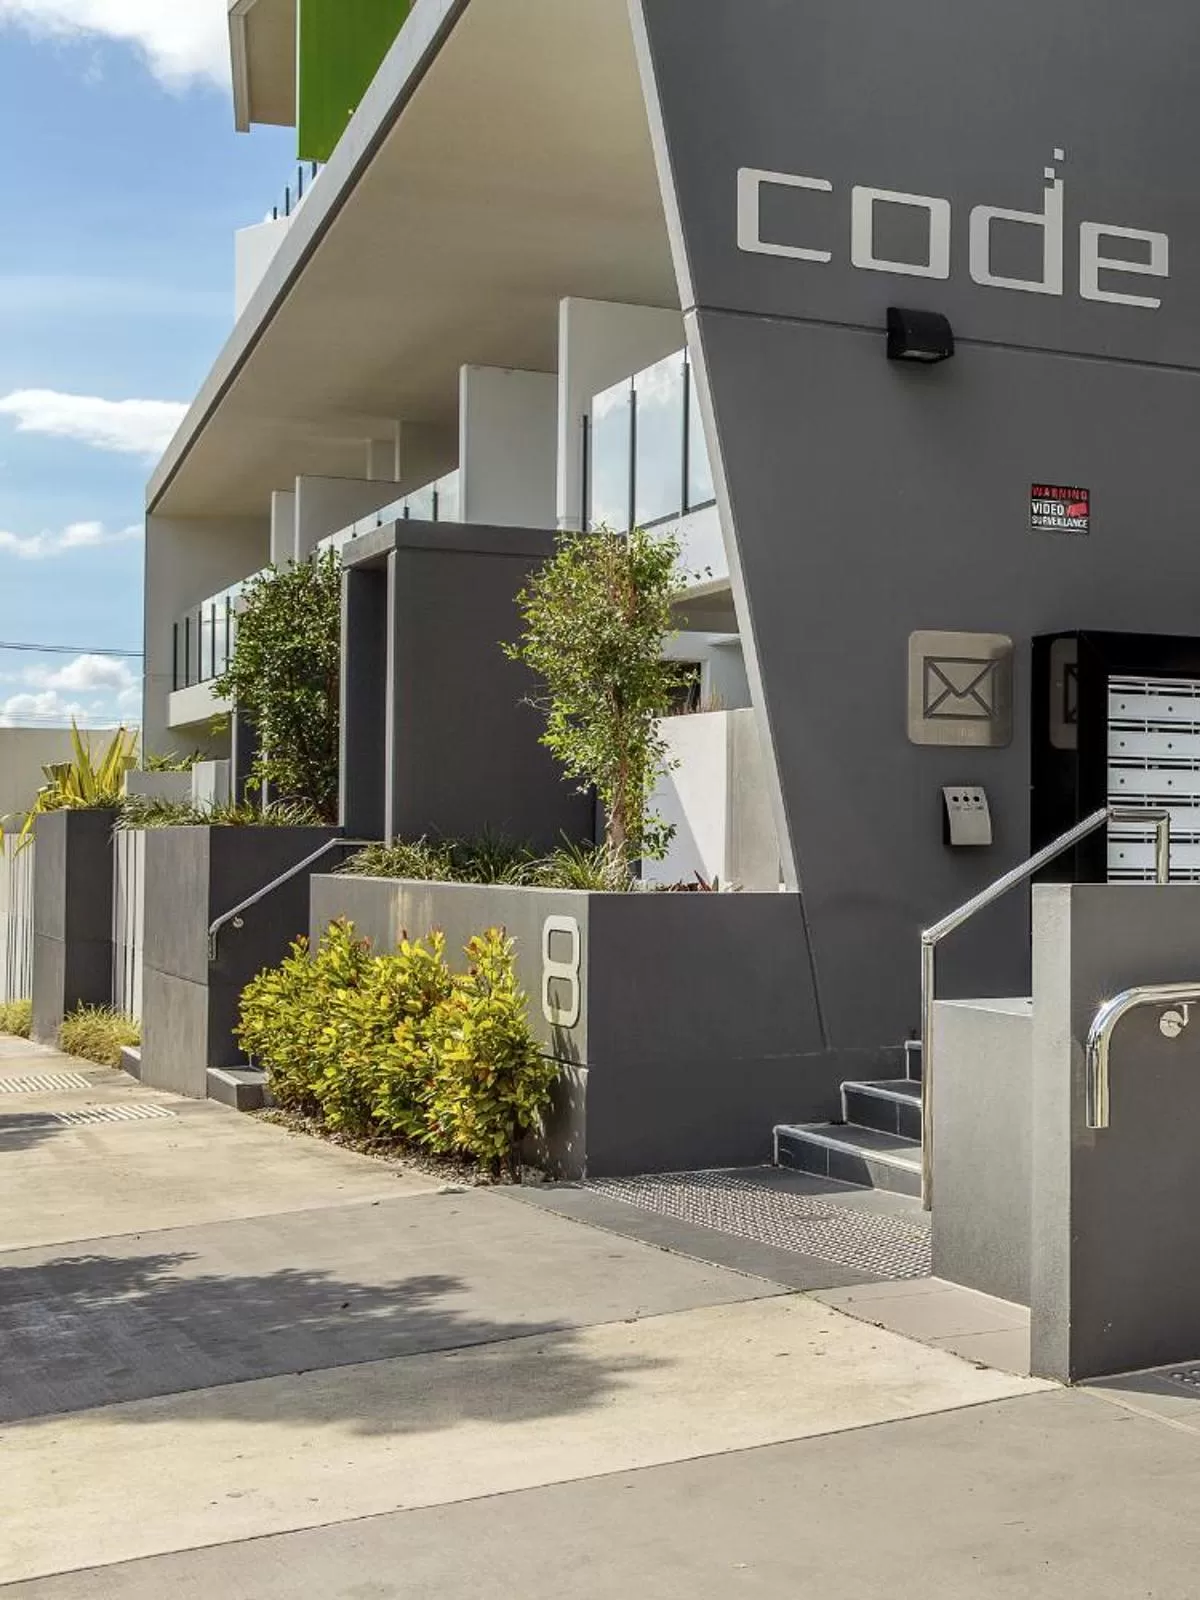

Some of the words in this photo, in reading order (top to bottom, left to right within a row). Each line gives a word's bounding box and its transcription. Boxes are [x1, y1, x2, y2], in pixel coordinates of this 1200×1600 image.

[737, 147, 1169, 308] code
[1032, 486, 1088, 500] WARNING
[1032, 502, 1065, 516] VIDEO
[1032, 516, 1088, 528] SURVEILLANCE
[542, 915, 580, 1027] 8
